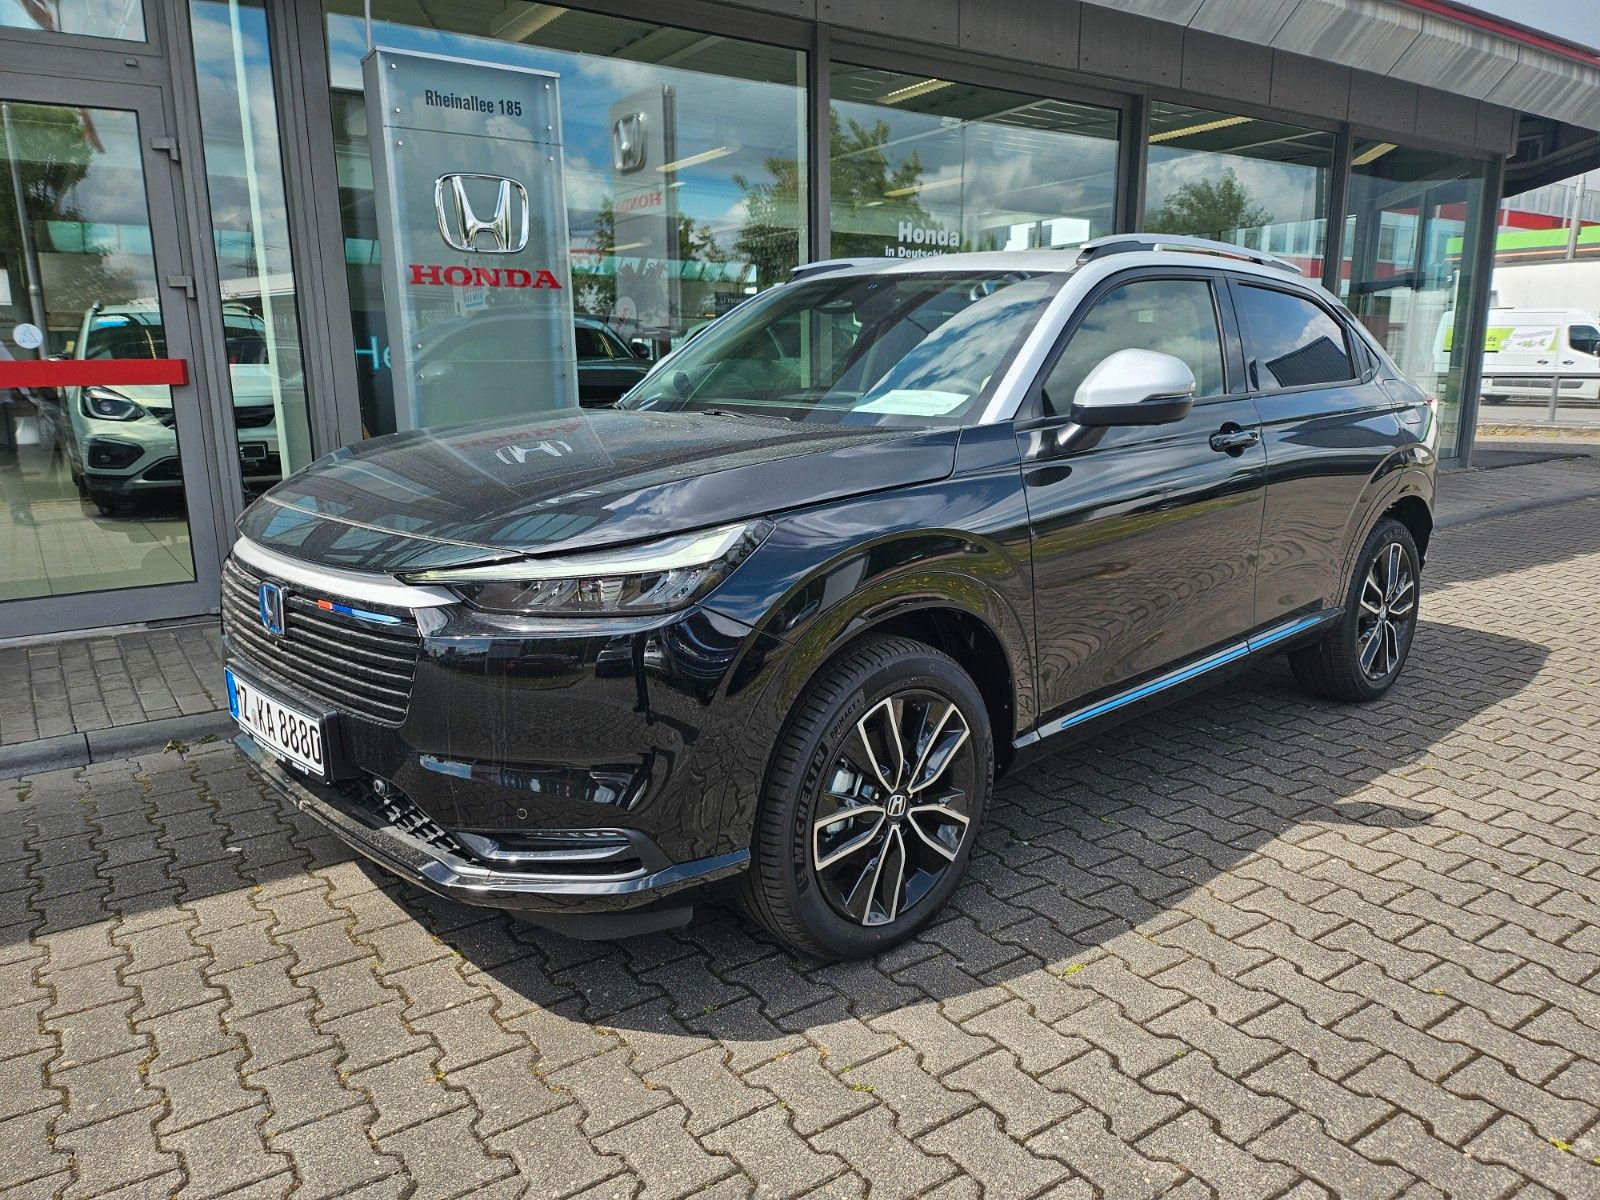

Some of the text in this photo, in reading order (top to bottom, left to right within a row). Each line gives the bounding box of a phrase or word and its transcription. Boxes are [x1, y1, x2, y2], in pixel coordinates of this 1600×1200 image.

[425, 89, 522, 117] Rheinallee 185
[898, 221, 960, 247] Honda
[885, 245, 895, 257] in
[409, 264, 562, 289] HONDA
[256, 695, 277, 742] KA
[278, 708, 323, 766] 8880
[830, 700, 857, 739] PRIMACY
[793, 747, 826, 864] MICHELIN
